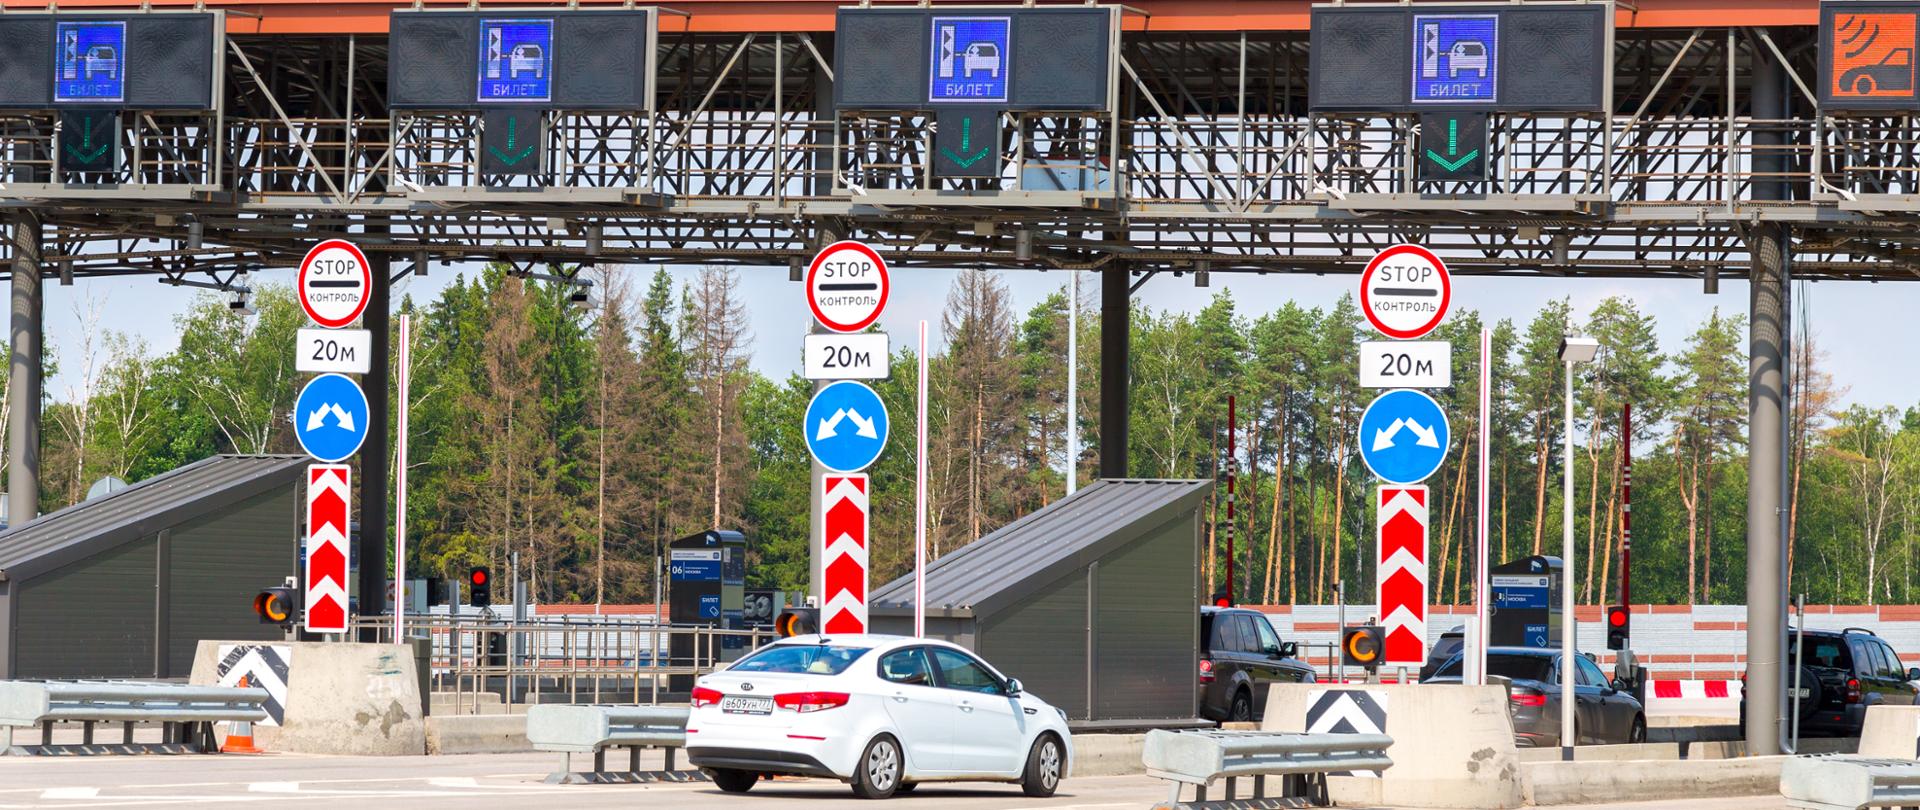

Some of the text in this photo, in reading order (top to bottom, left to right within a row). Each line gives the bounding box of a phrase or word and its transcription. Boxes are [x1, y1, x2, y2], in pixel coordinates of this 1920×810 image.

[69, 84, 112, 96] БИЛЕТ
[493, 83, 539, 96] БИЛЕТ
[946, 83, 994, 96] БИЛЕТ
[1429, 83, 1482, 97] БИЛЕТ
[314, 259, 355, 275] STOP
[824, 261, 871, 278] STOP
[1380, 265, 1432, 283] STOP
[309, 293, 360, 303] КОНТРОЛЬ
[819, 296, 877, 307] КОНТРОЛЬ
[1374, 301, 1437, 312] КОНТРОЛЬ
[672, 566, 683, 574] 06
